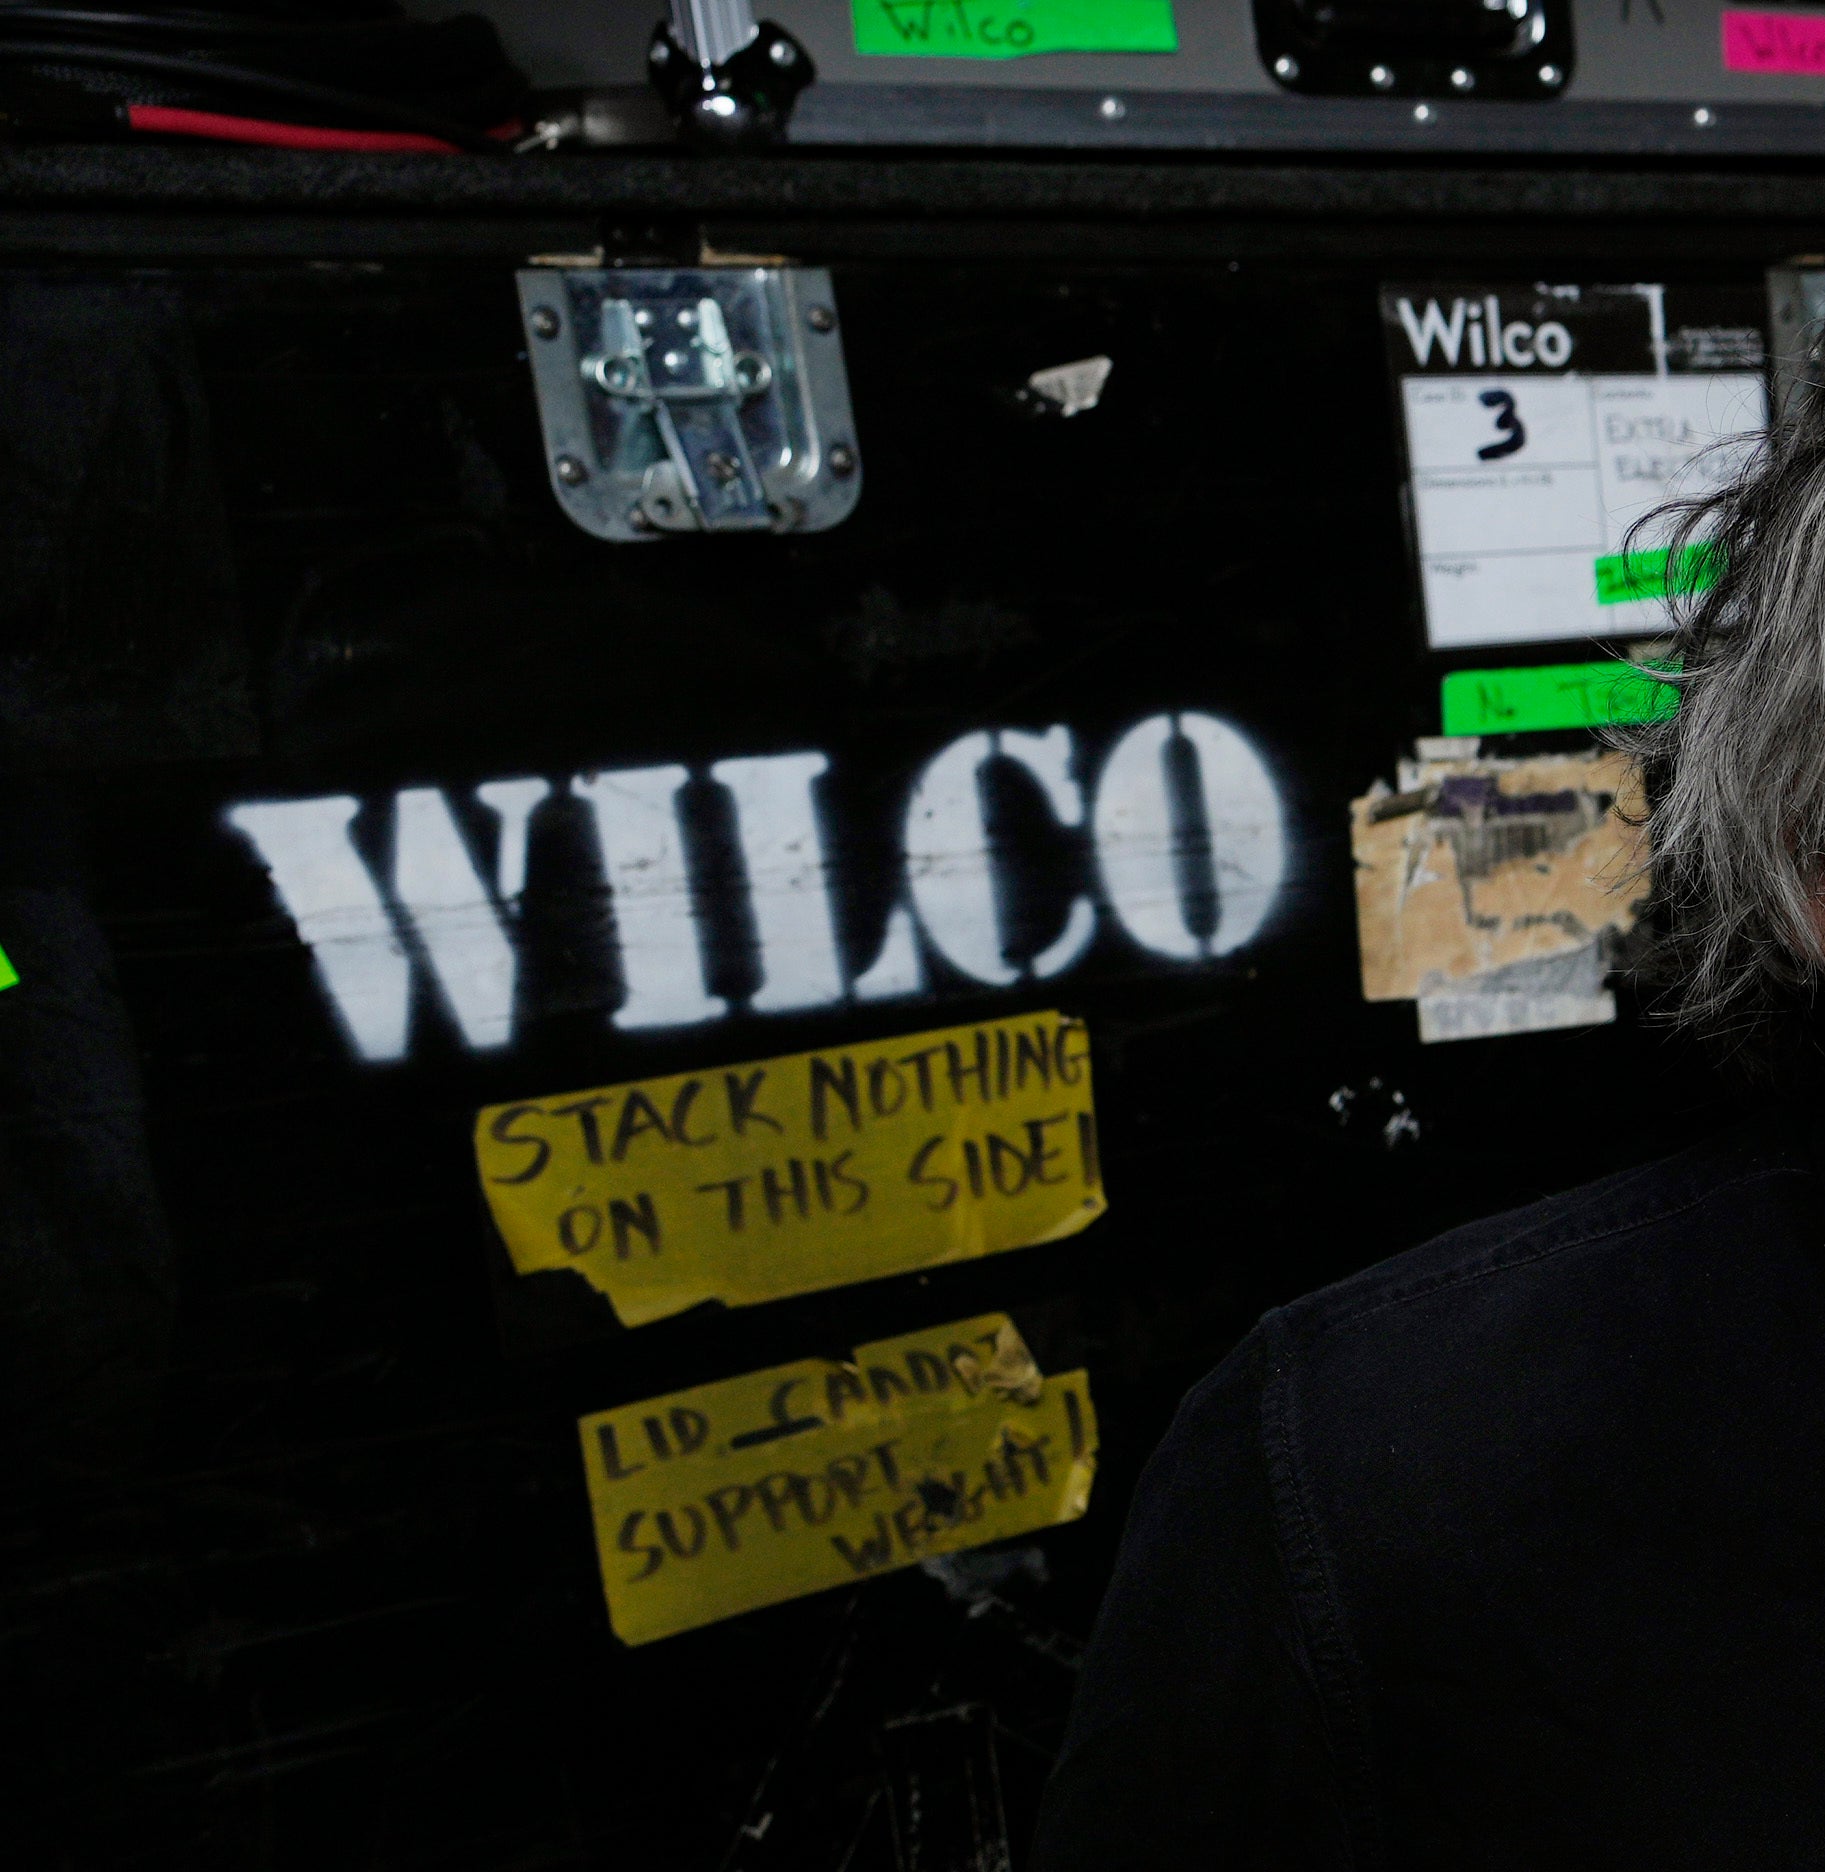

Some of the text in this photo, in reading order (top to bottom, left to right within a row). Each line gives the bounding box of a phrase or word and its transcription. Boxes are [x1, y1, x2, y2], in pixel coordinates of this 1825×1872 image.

[1396, 293, 1575, 369] Wilco
[1475, 386, 1528, 462] 3
[228, 710, 1288, 1062] WILCO
[489, 1021, 1091, 1186] STACK NOTHING
[558, 1111, 1102, 1264] ON THIS SIDE!
[595, 1406, 712, 1481] LID
[616, 1440, 899, 1586] SUPPORT
